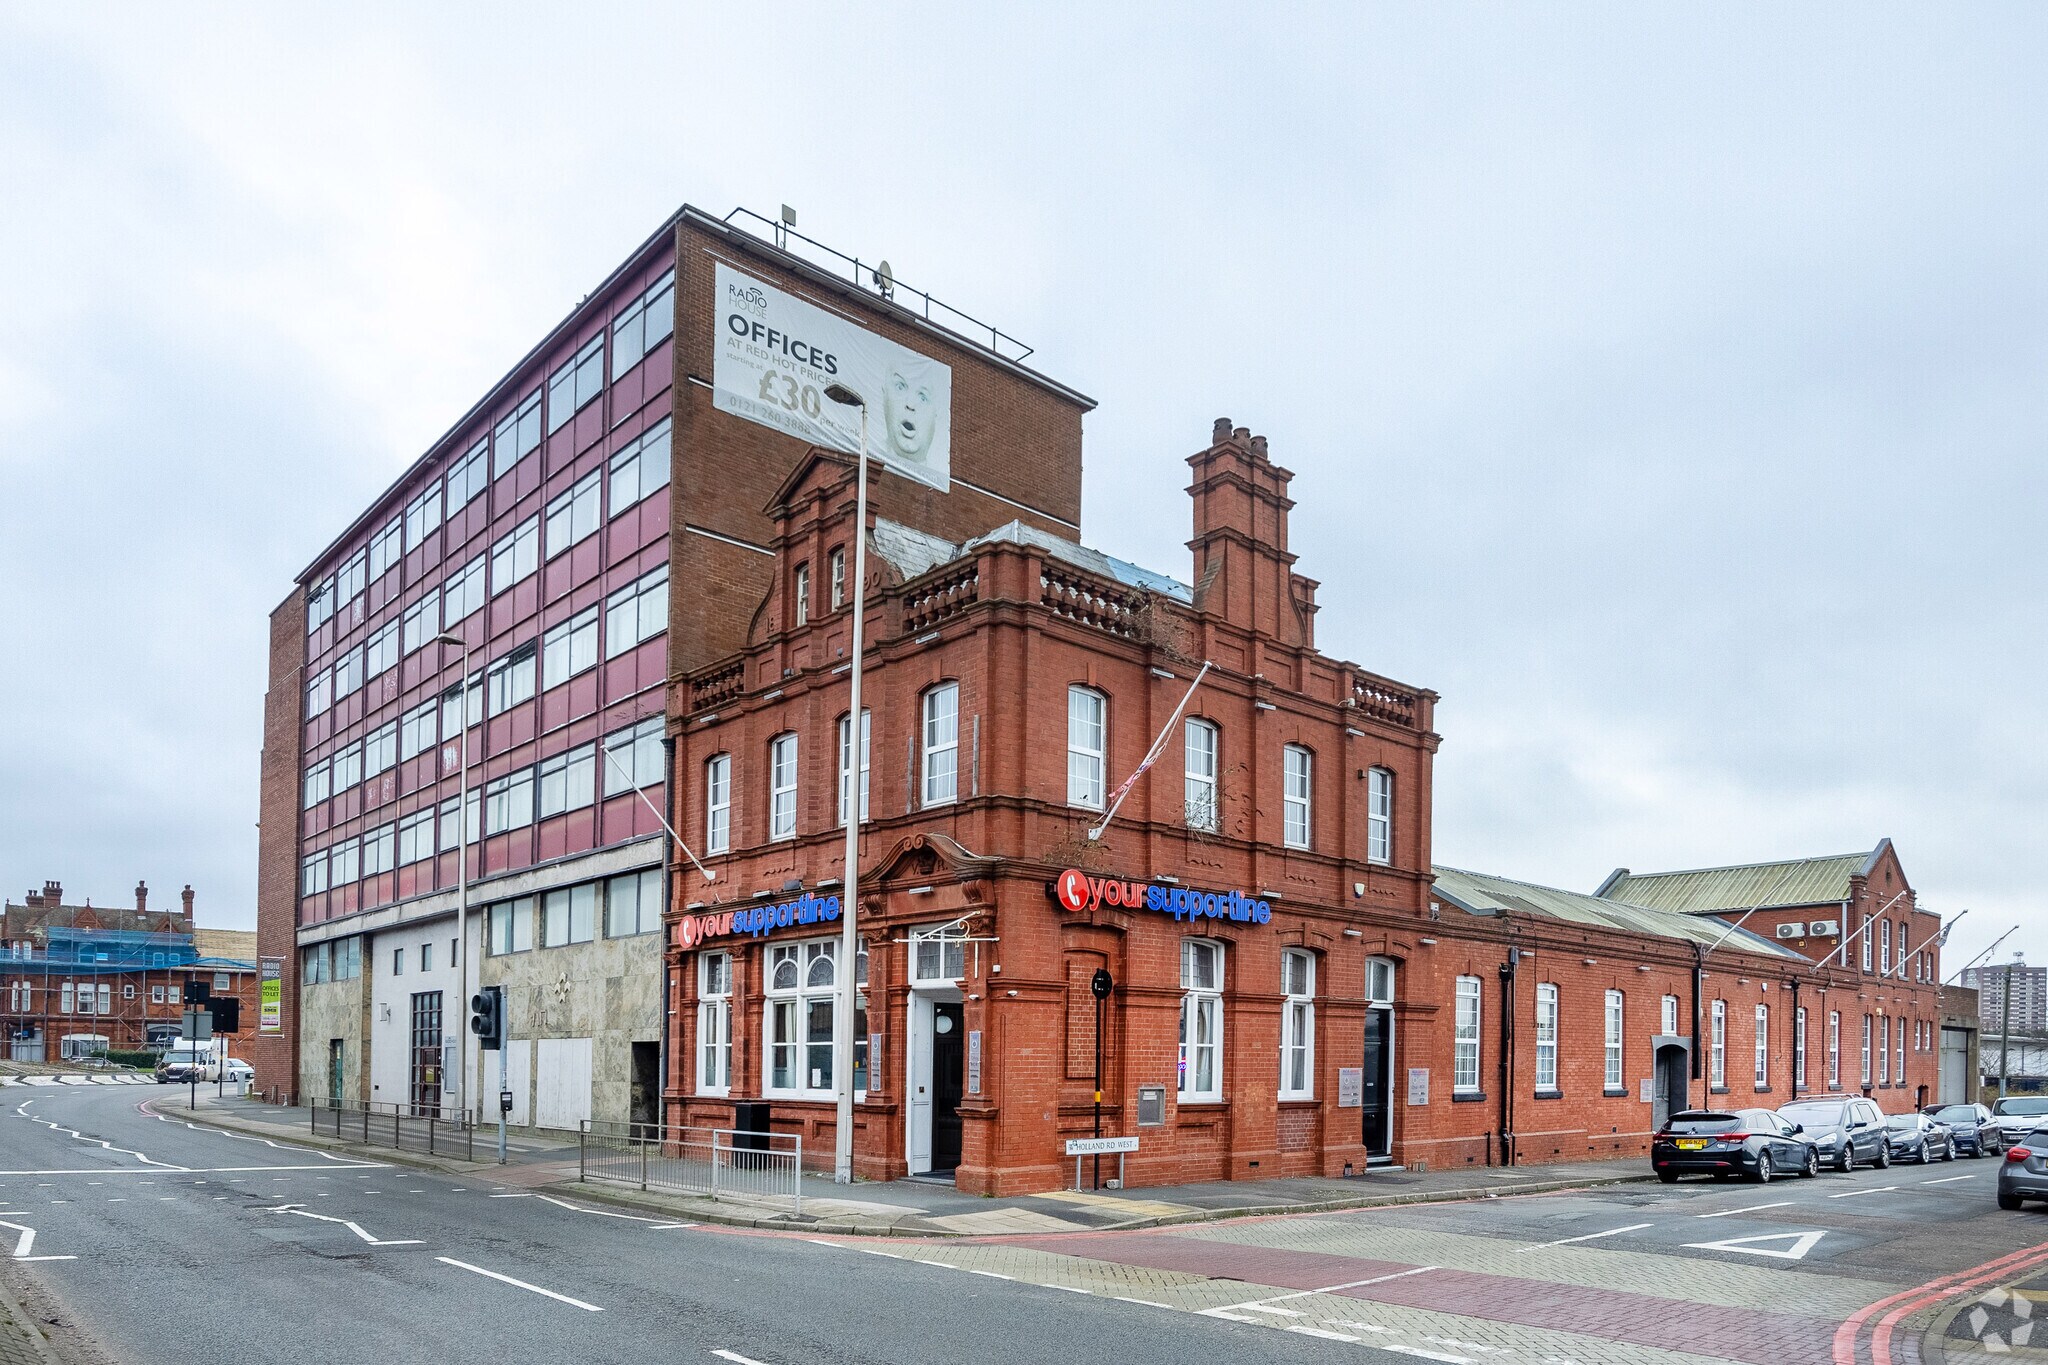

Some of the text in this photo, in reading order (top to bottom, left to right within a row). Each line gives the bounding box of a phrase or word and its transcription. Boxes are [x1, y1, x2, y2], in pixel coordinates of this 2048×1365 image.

[728, 284, 768, 309] RADIO
[728, 295, 768, 320] HOUSE
[727, 336, 743, 350] AT
[745, 343, 769, 361] RED
[772, 353, 798, 373] HOT
[728, 313, 838, 375] OFFICES
[726, 352, 764, 372] starting at
[729, 395, 756, 413] 0121
[758, 369, 821, 419] £30
[820, 416, 861, 437] per week
[1076, 1140, 1133, 1151] HOLLAND RD WEST
